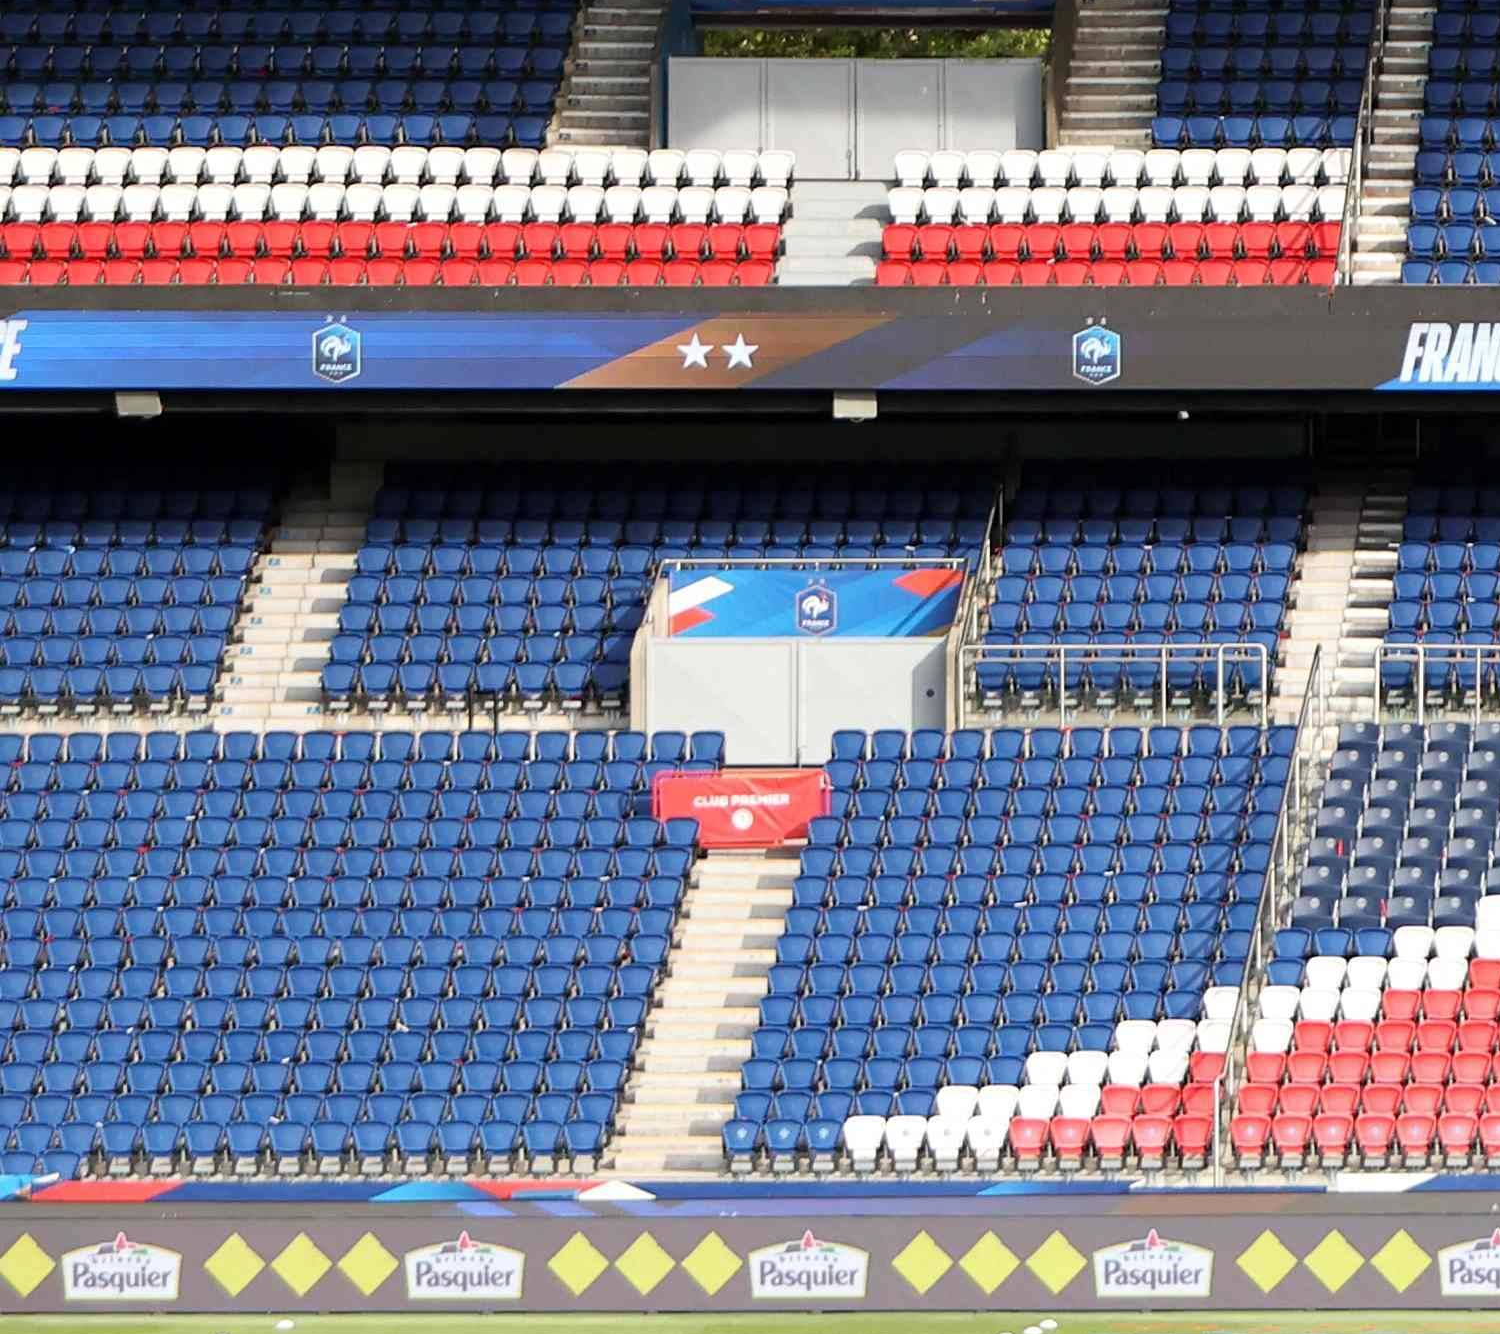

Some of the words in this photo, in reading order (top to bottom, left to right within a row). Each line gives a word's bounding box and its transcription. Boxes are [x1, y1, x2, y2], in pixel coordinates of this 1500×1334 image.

[693, 795, 729, 808] CLUB
[730, 793, 790, 808] PREMIER
[72, 1262, 172, 1293] Pasquier
[415, 1261, 515, 1292] Pasquier
[759, 1260, 859, 1291] Pasquier
[1104, 1259, 1204, 1290] Pasquier
